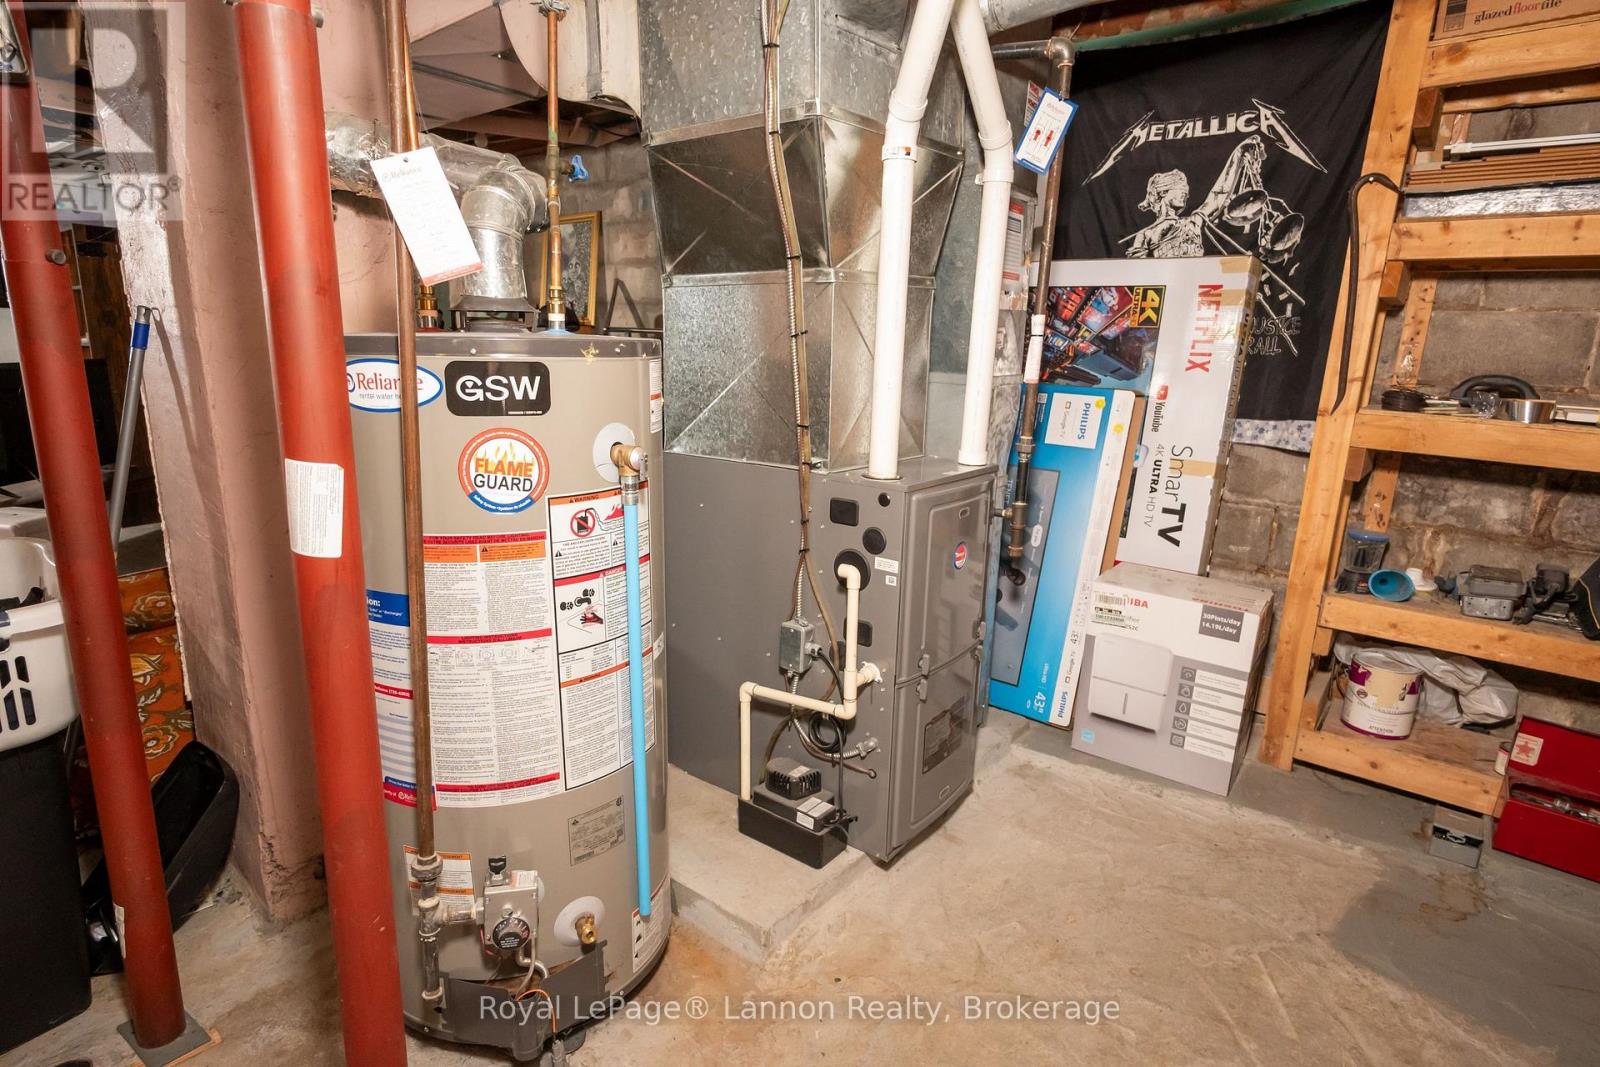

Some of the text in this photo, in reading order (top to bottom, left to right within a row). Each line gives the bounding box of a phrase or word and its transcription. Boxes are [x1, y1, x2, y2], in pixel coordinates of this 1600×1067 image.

[1080, 98, 1328, 186] METALLICA
[1139, 289, 1161, 324] 4K
[1184, 284, 1223, 374] NETFLIX
[455, 375, 541, 402] GSW
[1077, 402, 1091, 440] PHILIPS
[1151, 401, 1165, 433] YouTube
[1154, 443, 1165, 457] 4K
[473, 473, 533, 493] GUARD
[474, 457, 534, 478] FLAME
[1148, 459, 1163, 494] ULTRA
